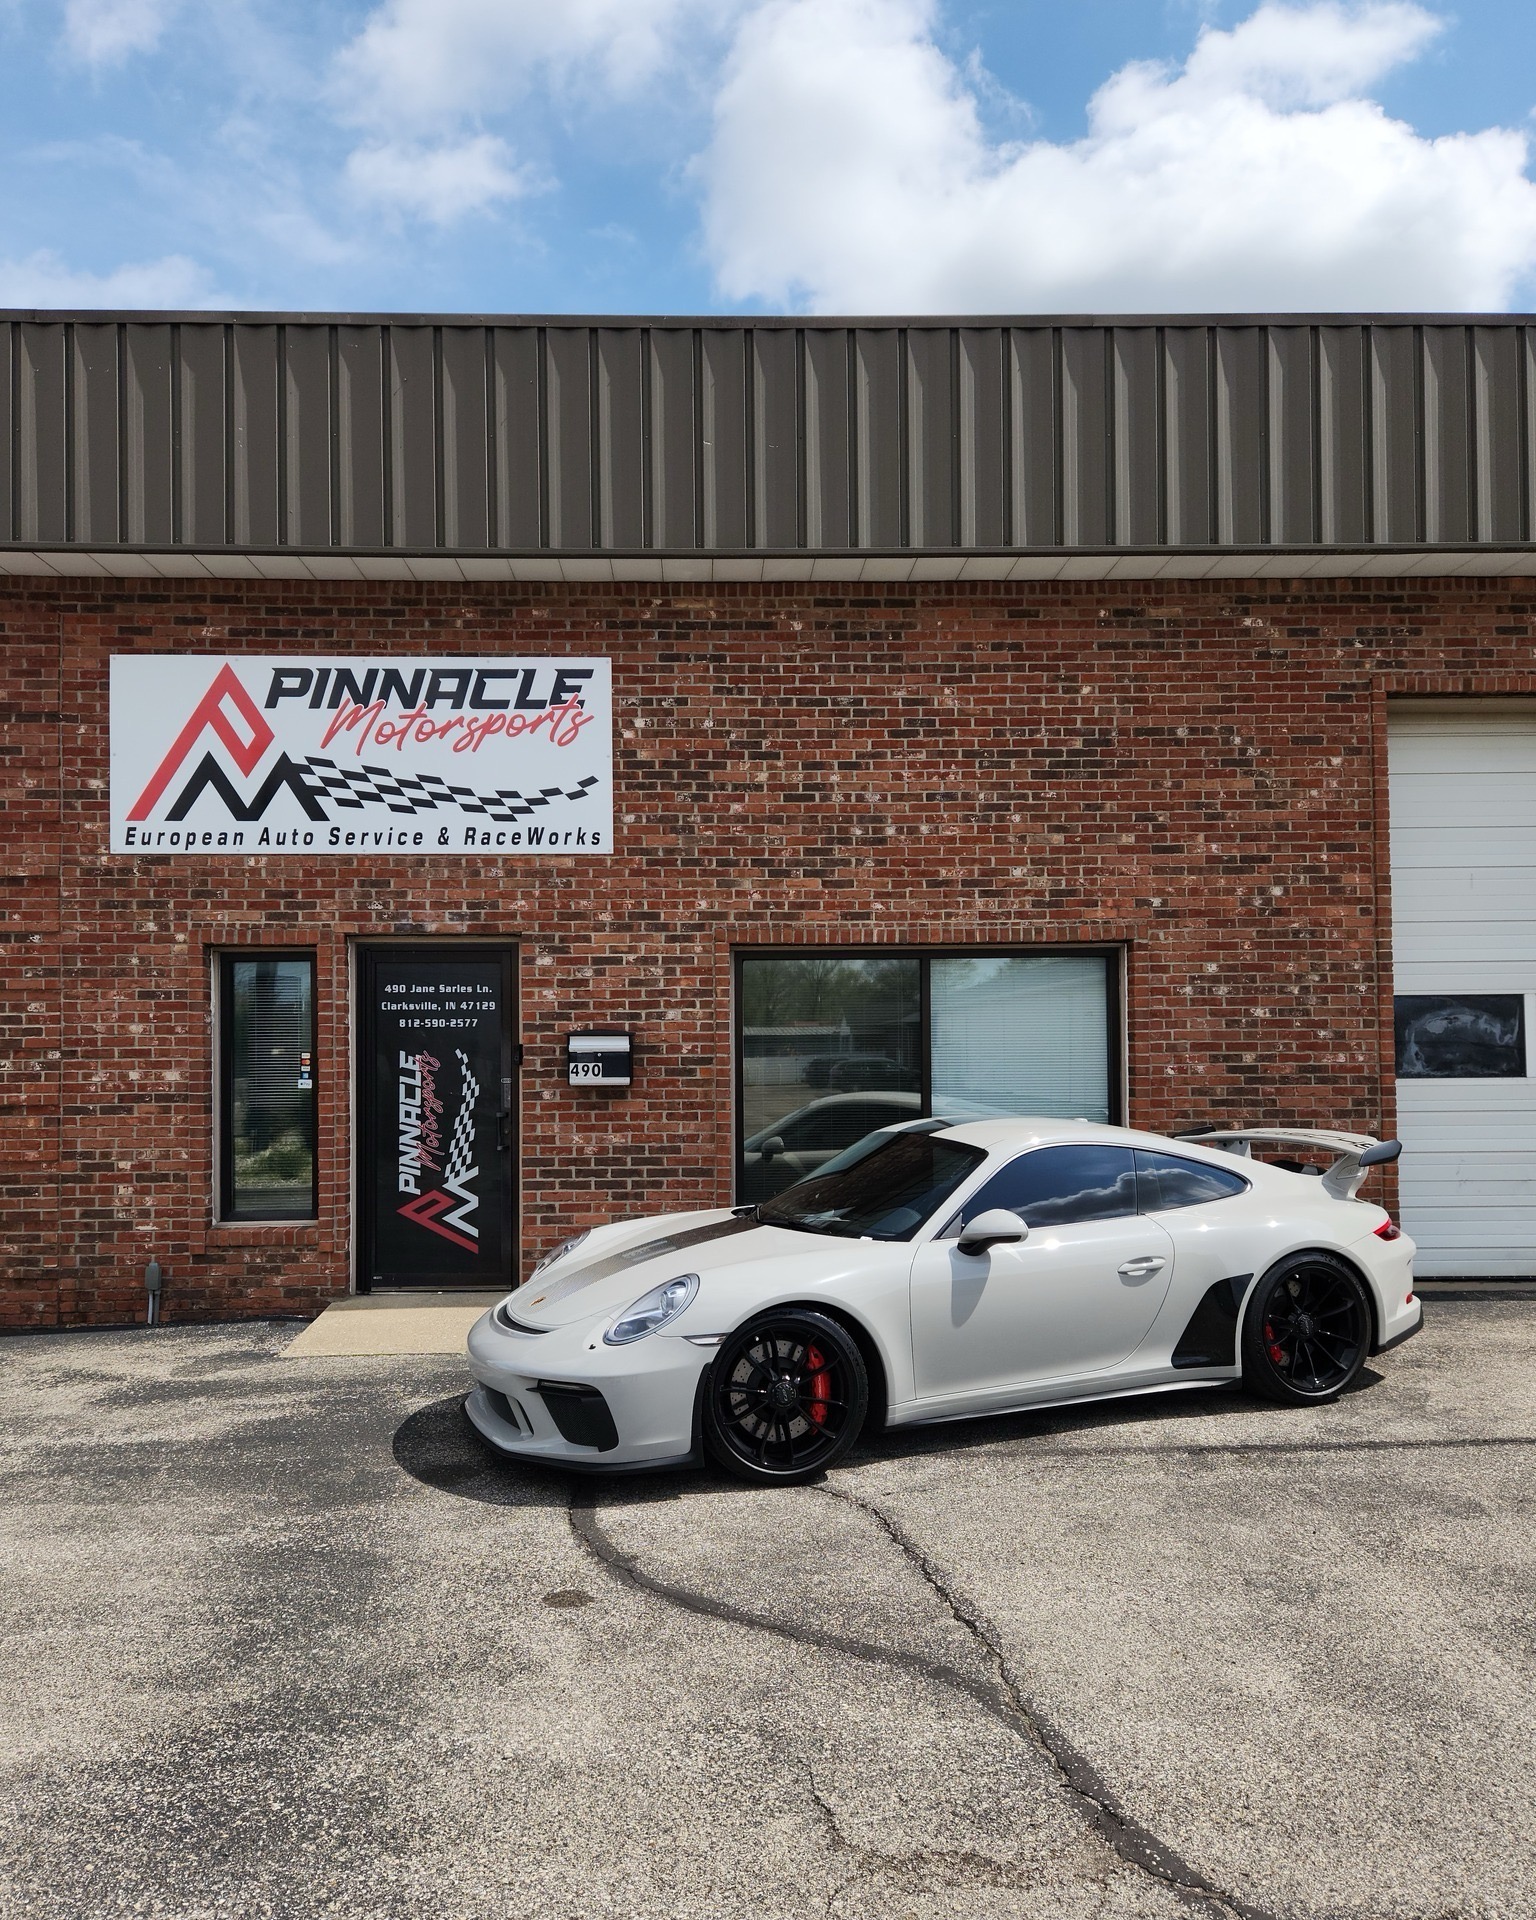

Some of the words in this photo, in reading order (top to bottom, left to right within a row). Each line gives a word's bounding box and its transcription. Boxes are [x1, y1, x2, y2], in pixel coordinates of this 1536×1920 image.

[264, 668, 594, 709] PINNACLE
[320, 694, 595, 757] Motorsports
[125, 826, 245, 851] European
[258, 826, 314, 846] Auto
[329, 826, 424, 846] Service
[437, 826, 450, 846] &
[464, 826, 601, 846] RaceWorks
[385, 984, 406, 993] 490
[410, 984, 435, 993] Jane
[439, 984, 473, 993] Sarles
[476, 984, 493, 993] Ln.
[381, 1001, 441, 1011] Clarksville,
[445, 1001, 456, 1010] IN
[460, 1001, 496, 1010] 47129
[399, 1018, 478, 1028] 812-590-2577
[571, 1064, 601, 1077] 490
[399, 1050, 422, 1195] PINNACLE
[413, 1050, 444, 1171] Motorsports
